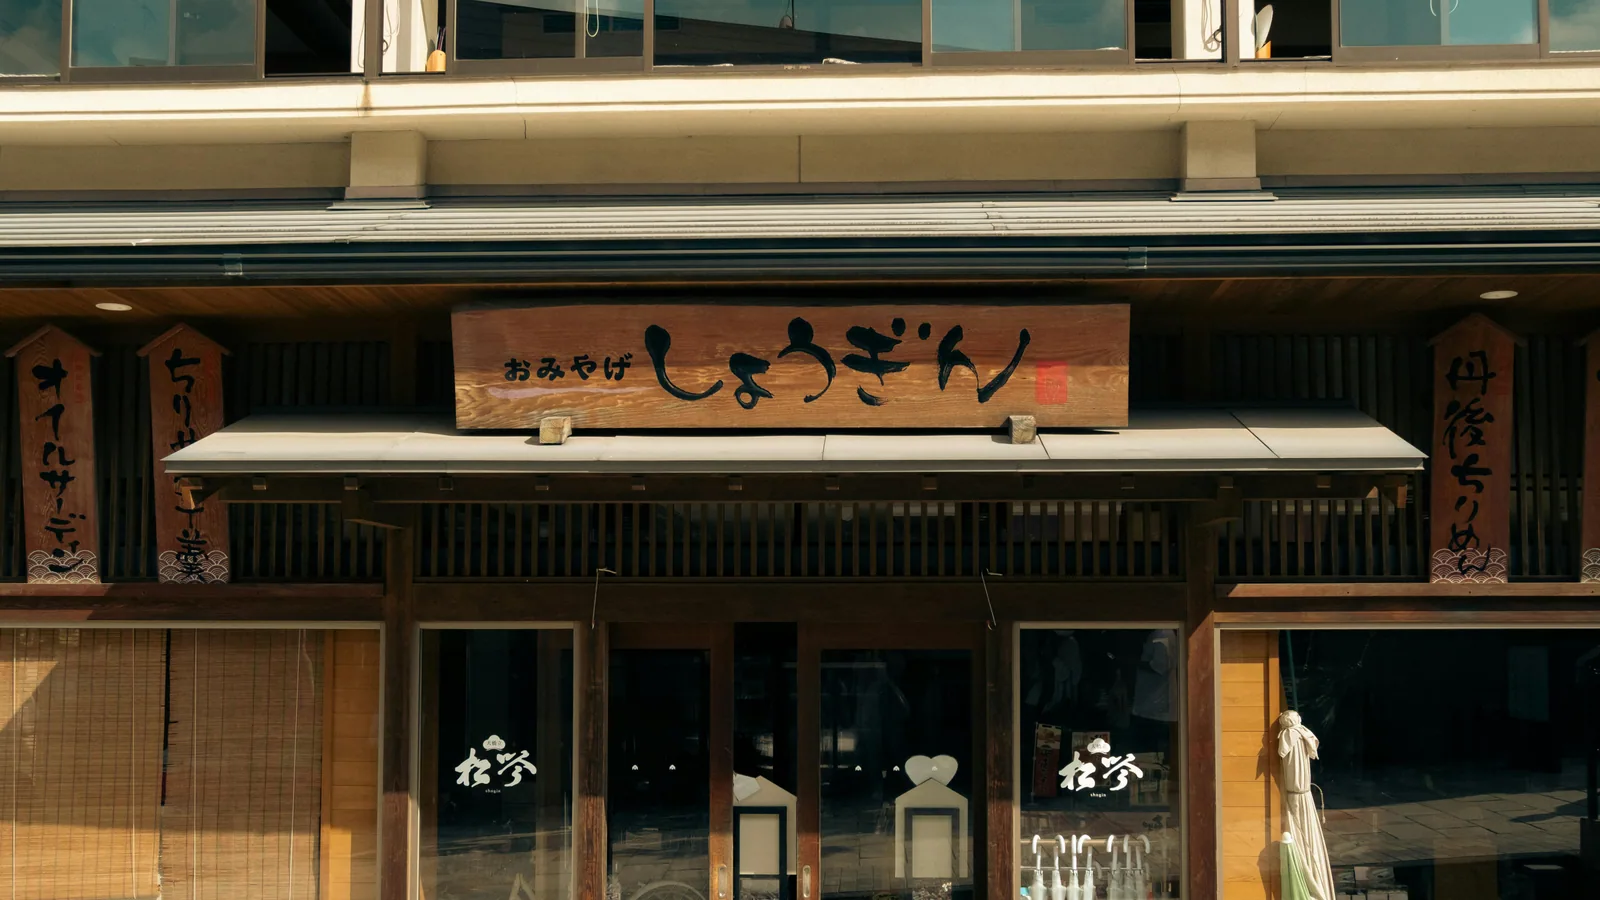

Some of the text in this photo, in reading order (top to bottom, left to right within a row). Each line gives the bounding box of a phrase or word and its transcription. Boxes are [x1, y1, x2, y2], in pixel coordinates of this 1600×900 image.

[32, 358, 86, 573] オイルサーディン
[504, 353, 633, 381] おみやげ
[645, 317, 1030, 409] しょうぎん
[1444, 350, 1496, 576] 丹後ちりめん
